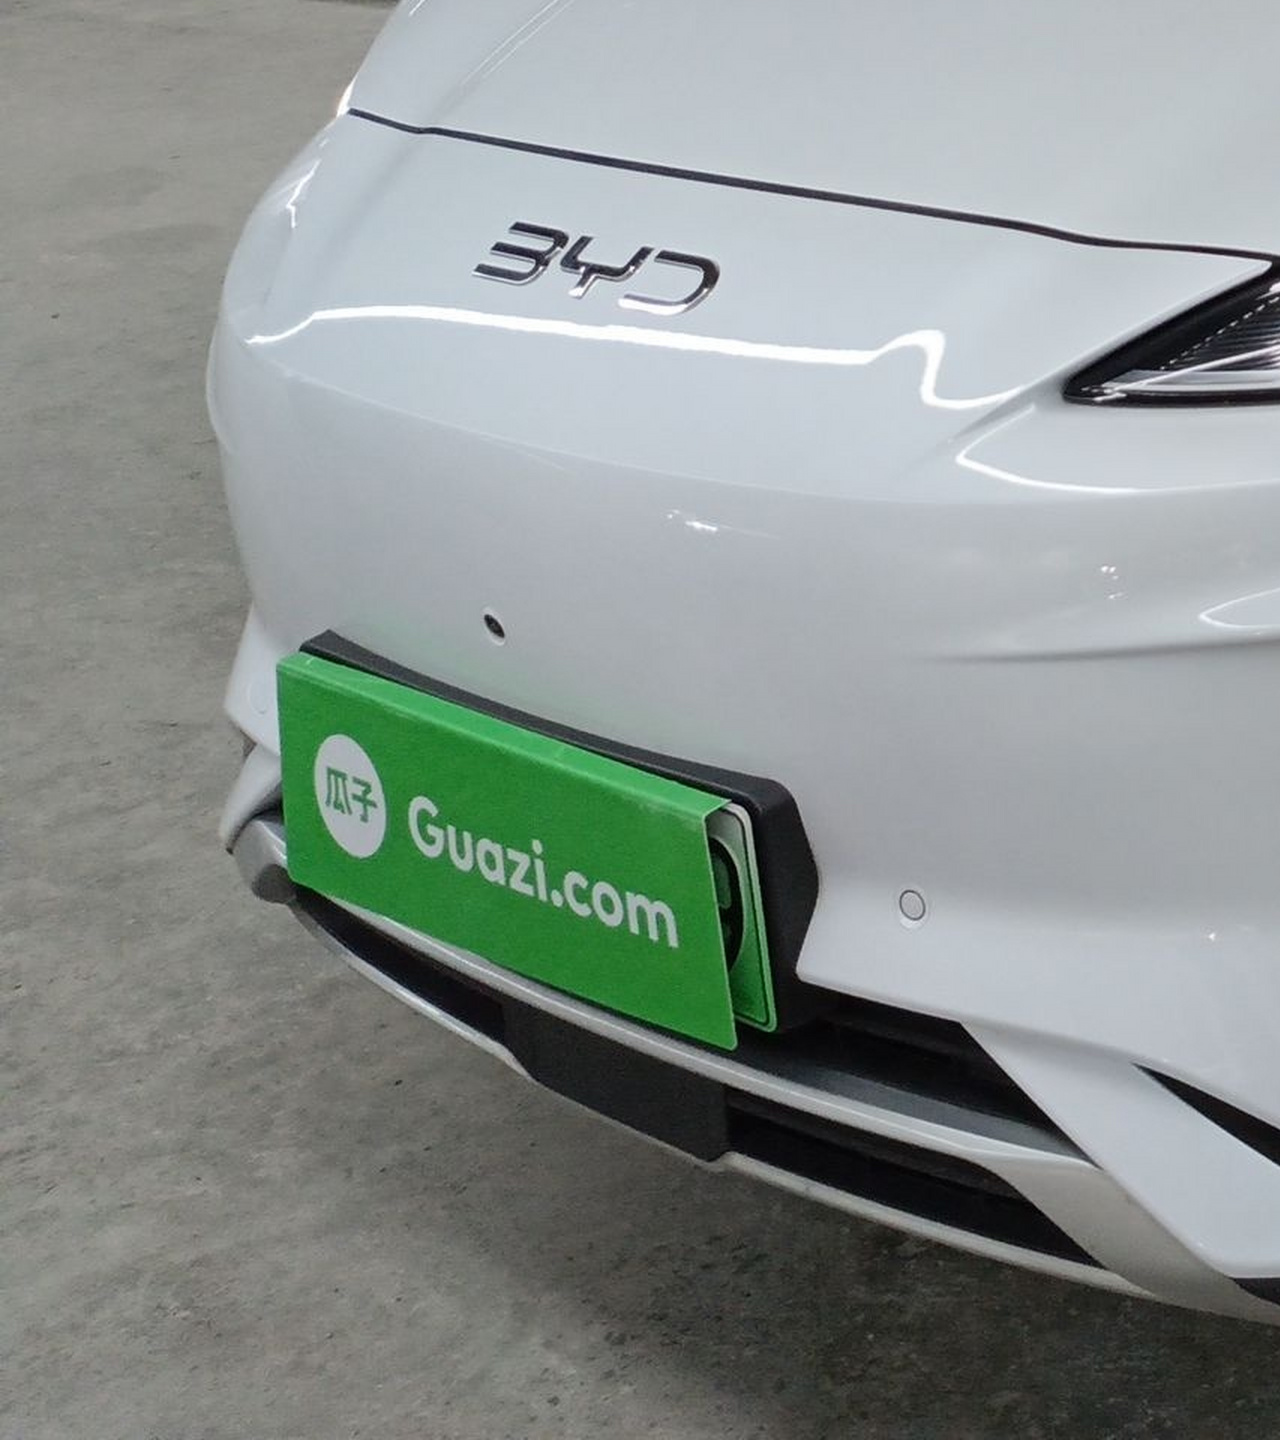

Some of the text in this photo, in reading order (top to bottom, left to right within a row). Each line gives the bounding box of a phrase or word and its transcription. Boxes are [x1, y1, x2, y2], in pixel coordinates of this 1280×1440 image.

[471, 221, 720, 316] BYD
[325, 766, 377, 824] 瓜子
[407, 795, 679, 949] Guazi.com
